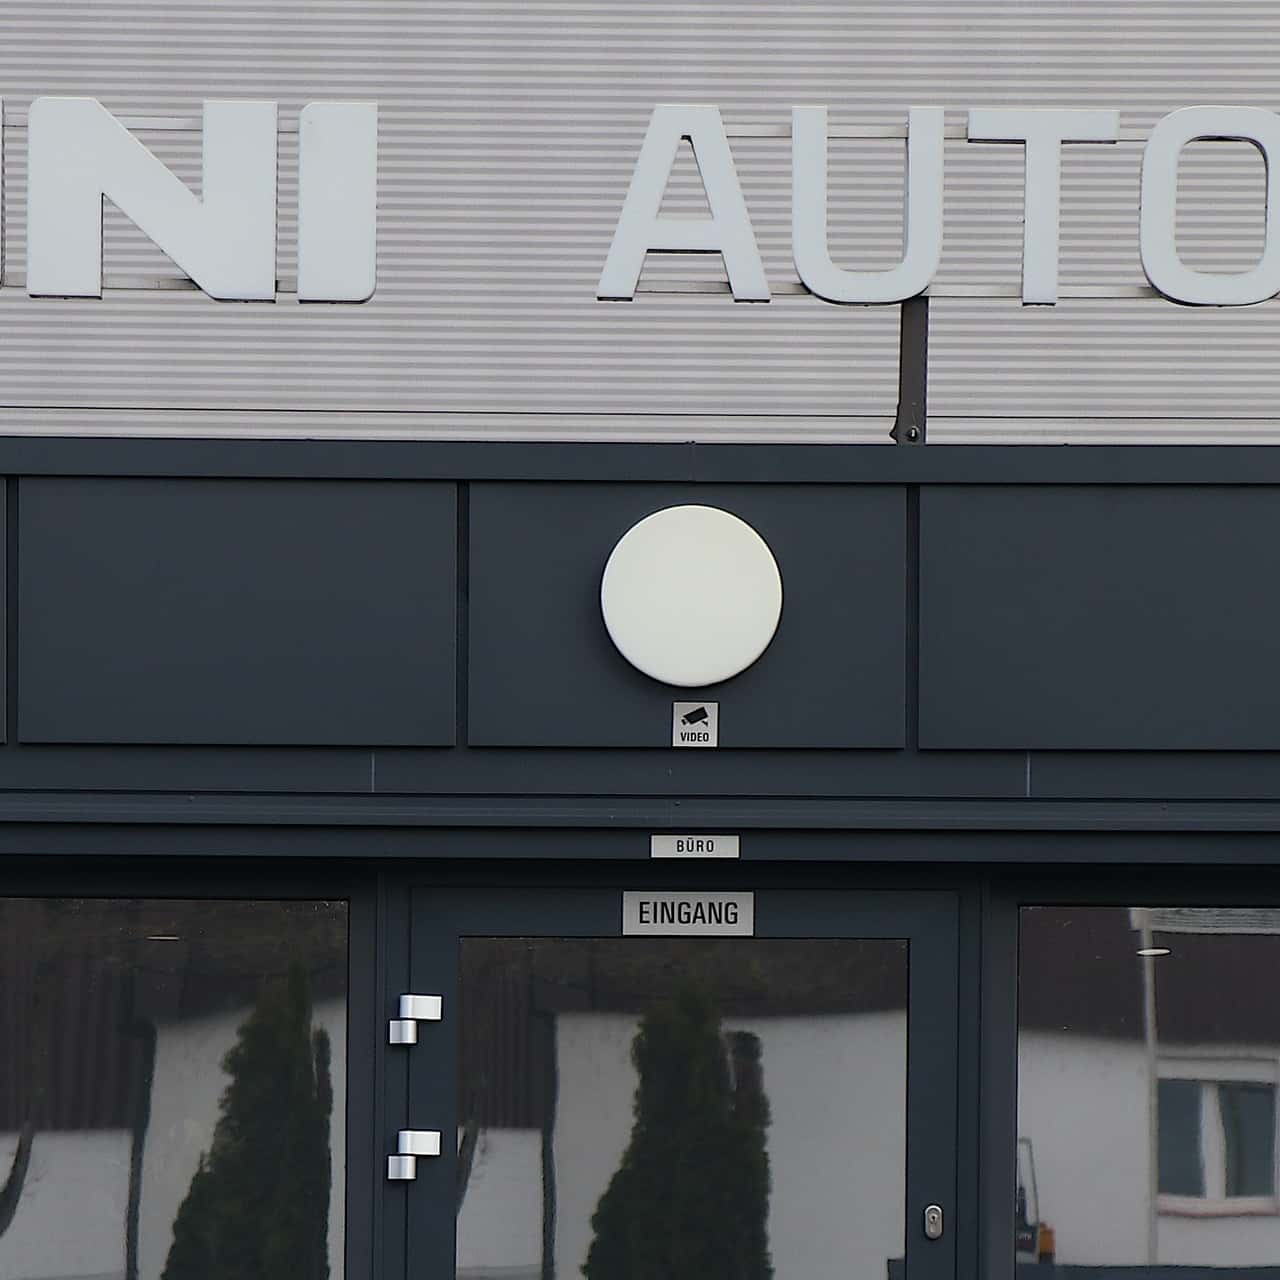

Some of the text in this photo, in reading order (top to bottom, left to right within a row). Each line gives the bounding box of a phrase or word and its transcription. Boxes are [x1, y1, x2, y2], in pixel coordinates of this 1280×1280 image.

[680, 731, 709, 742] VIDEO
[676, 837, 714, 853] BÜRO
[639, 901, 738, 924] EINGANG
